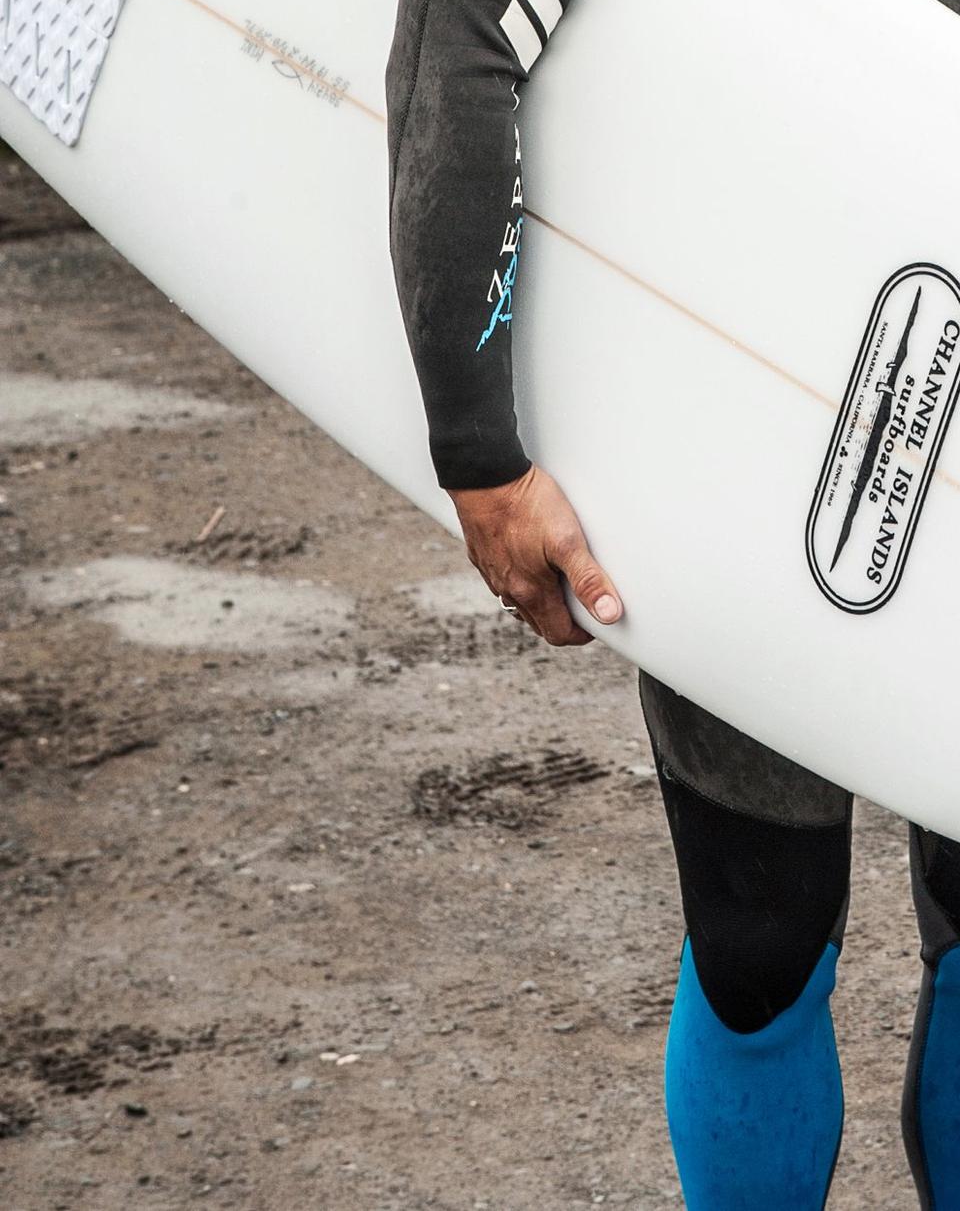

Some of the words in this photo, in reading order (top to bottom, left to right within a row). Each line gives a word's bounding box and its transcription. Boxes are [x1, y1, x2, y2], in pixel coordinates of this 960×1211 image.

[875, 321, 889, 348] SANTA
[862, 349, 879, 388] BARBARA
[904, 319, 960, 451] CHANNEL
[845, 394, 865, 444] CALIFORNIA
[868, 374, 915, 503] surfboards
[832, 462, 843, 487] SINCE
[866, 466, 914, 585] ISLANDS
